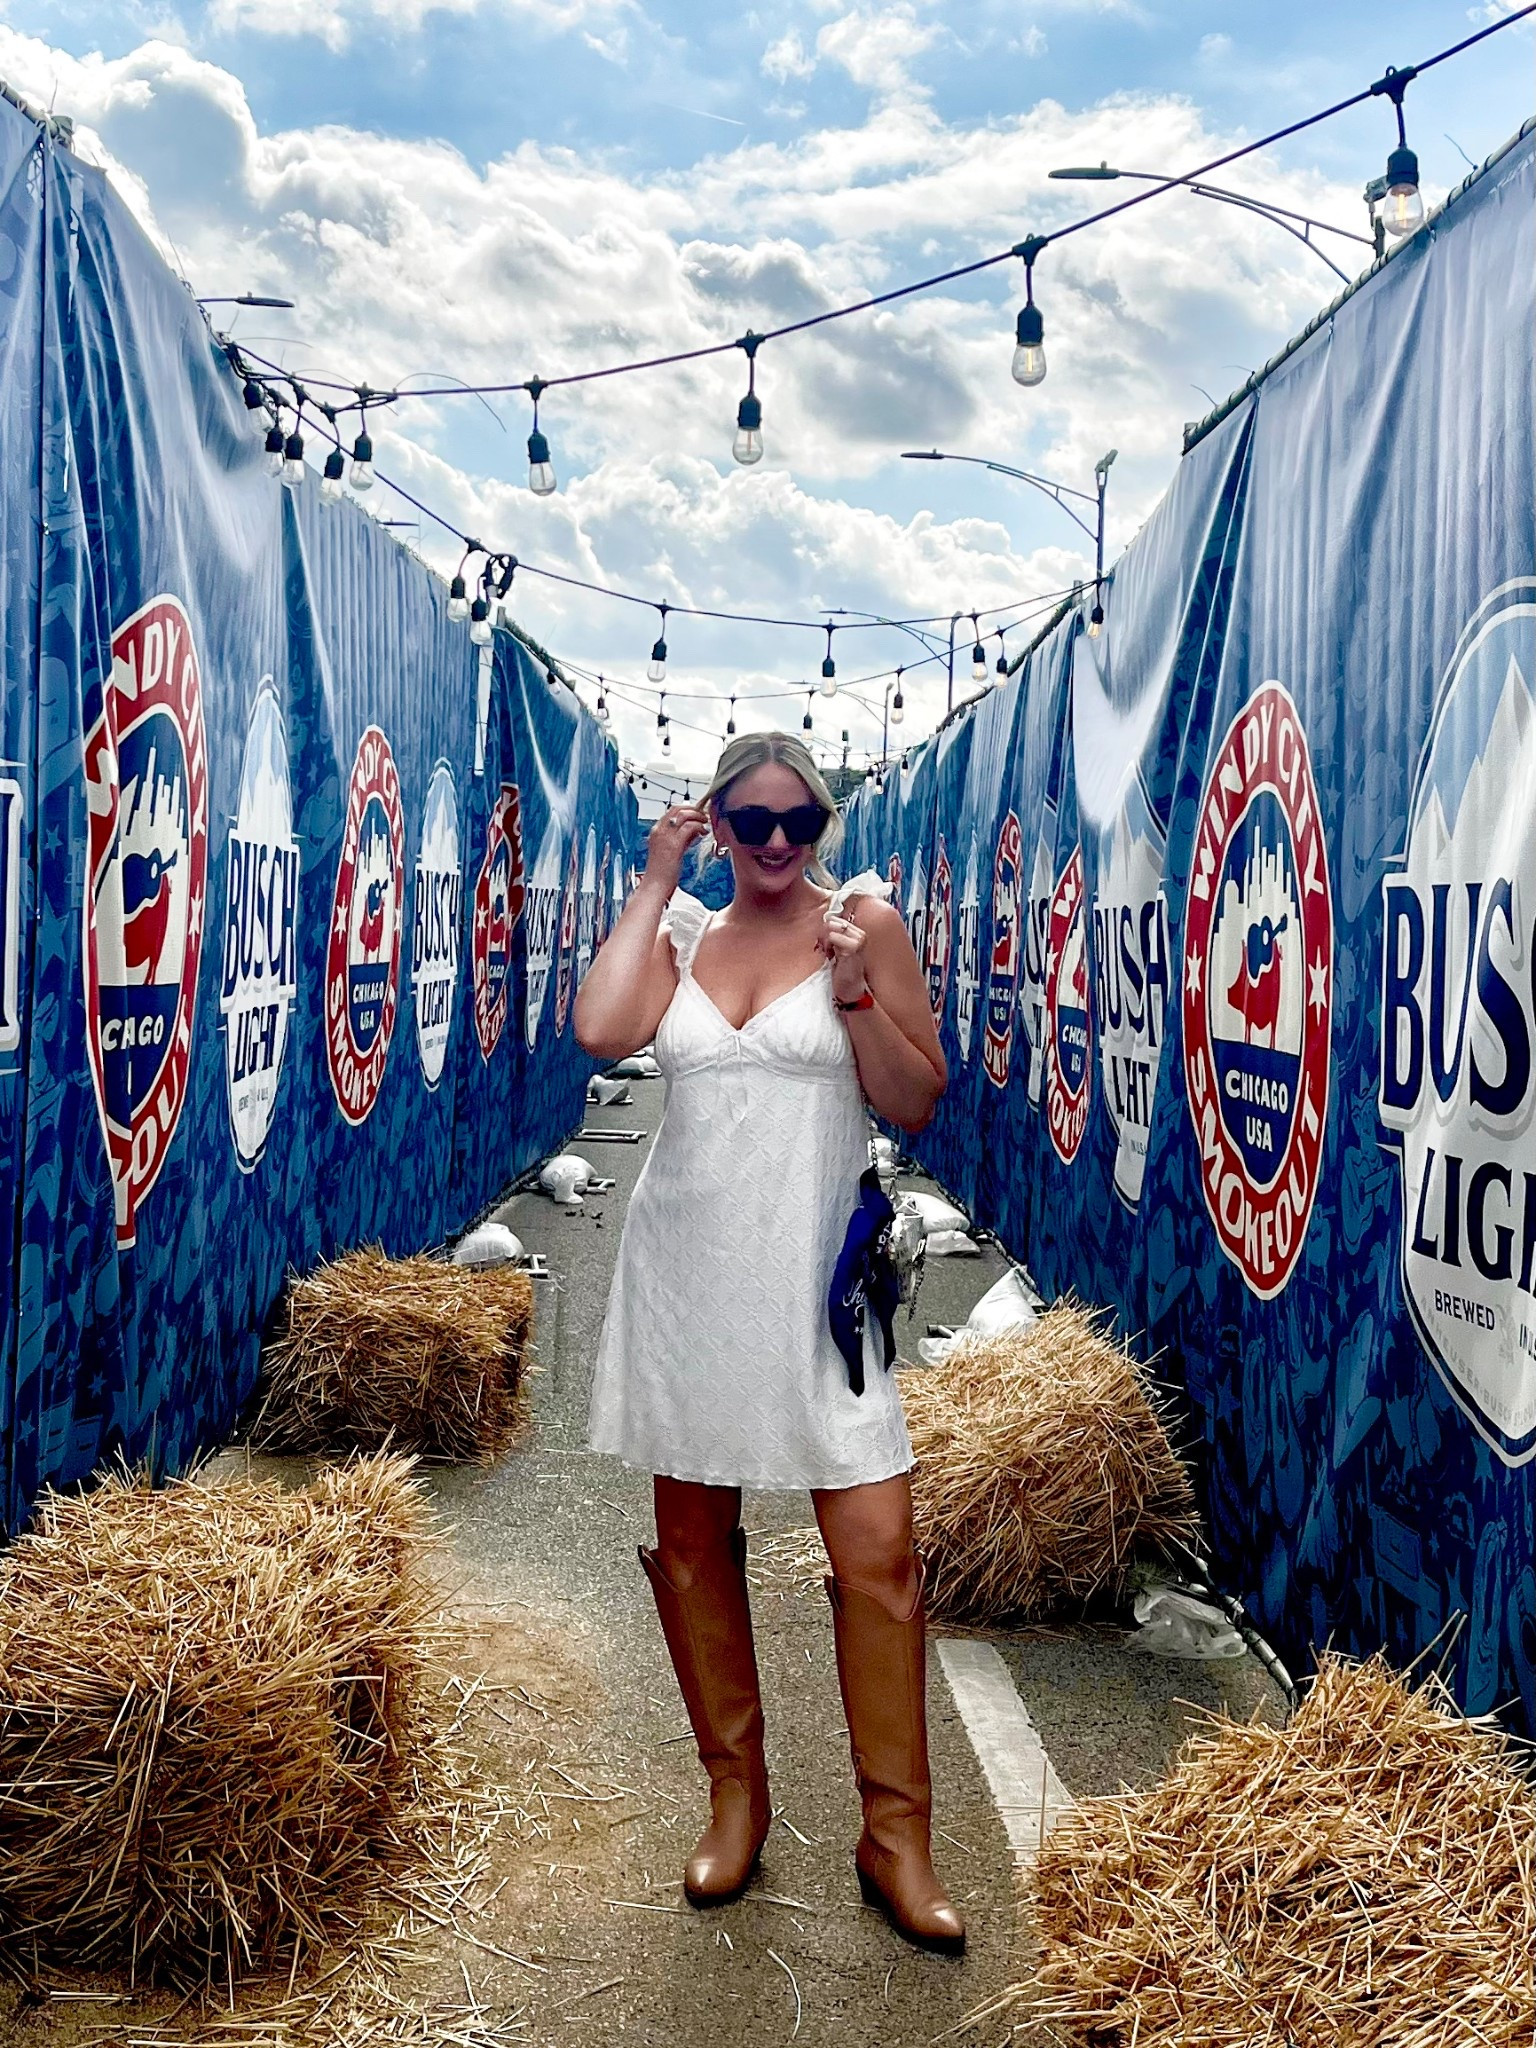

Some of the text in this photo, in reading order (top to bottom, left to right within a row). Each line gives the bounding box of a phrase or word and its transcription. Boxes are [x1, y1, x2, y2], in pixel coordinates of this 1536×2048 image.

[1192, 702, 1274, 901] WINDY
[1278, 717, 1324, 899] CITY
[222, 838, 298, 999] BUSCH
[413, 869, 459, 973] BUSCH
[353, 981, 385, 1005] CHICAGO
[421, 979, 451, 1030] LIGHT
[1382, 877, 1536, 1116] BUS
[359, 1010, 375, 1031] USA
[1225, 1069, 1289, 1114] CHICAGO
[1246, 1115, 1273, 1153] USA
[1191, 1046, 1320, 1275] SMOKEOUT
[1434, 1288, 1495, 1331] BREWED
